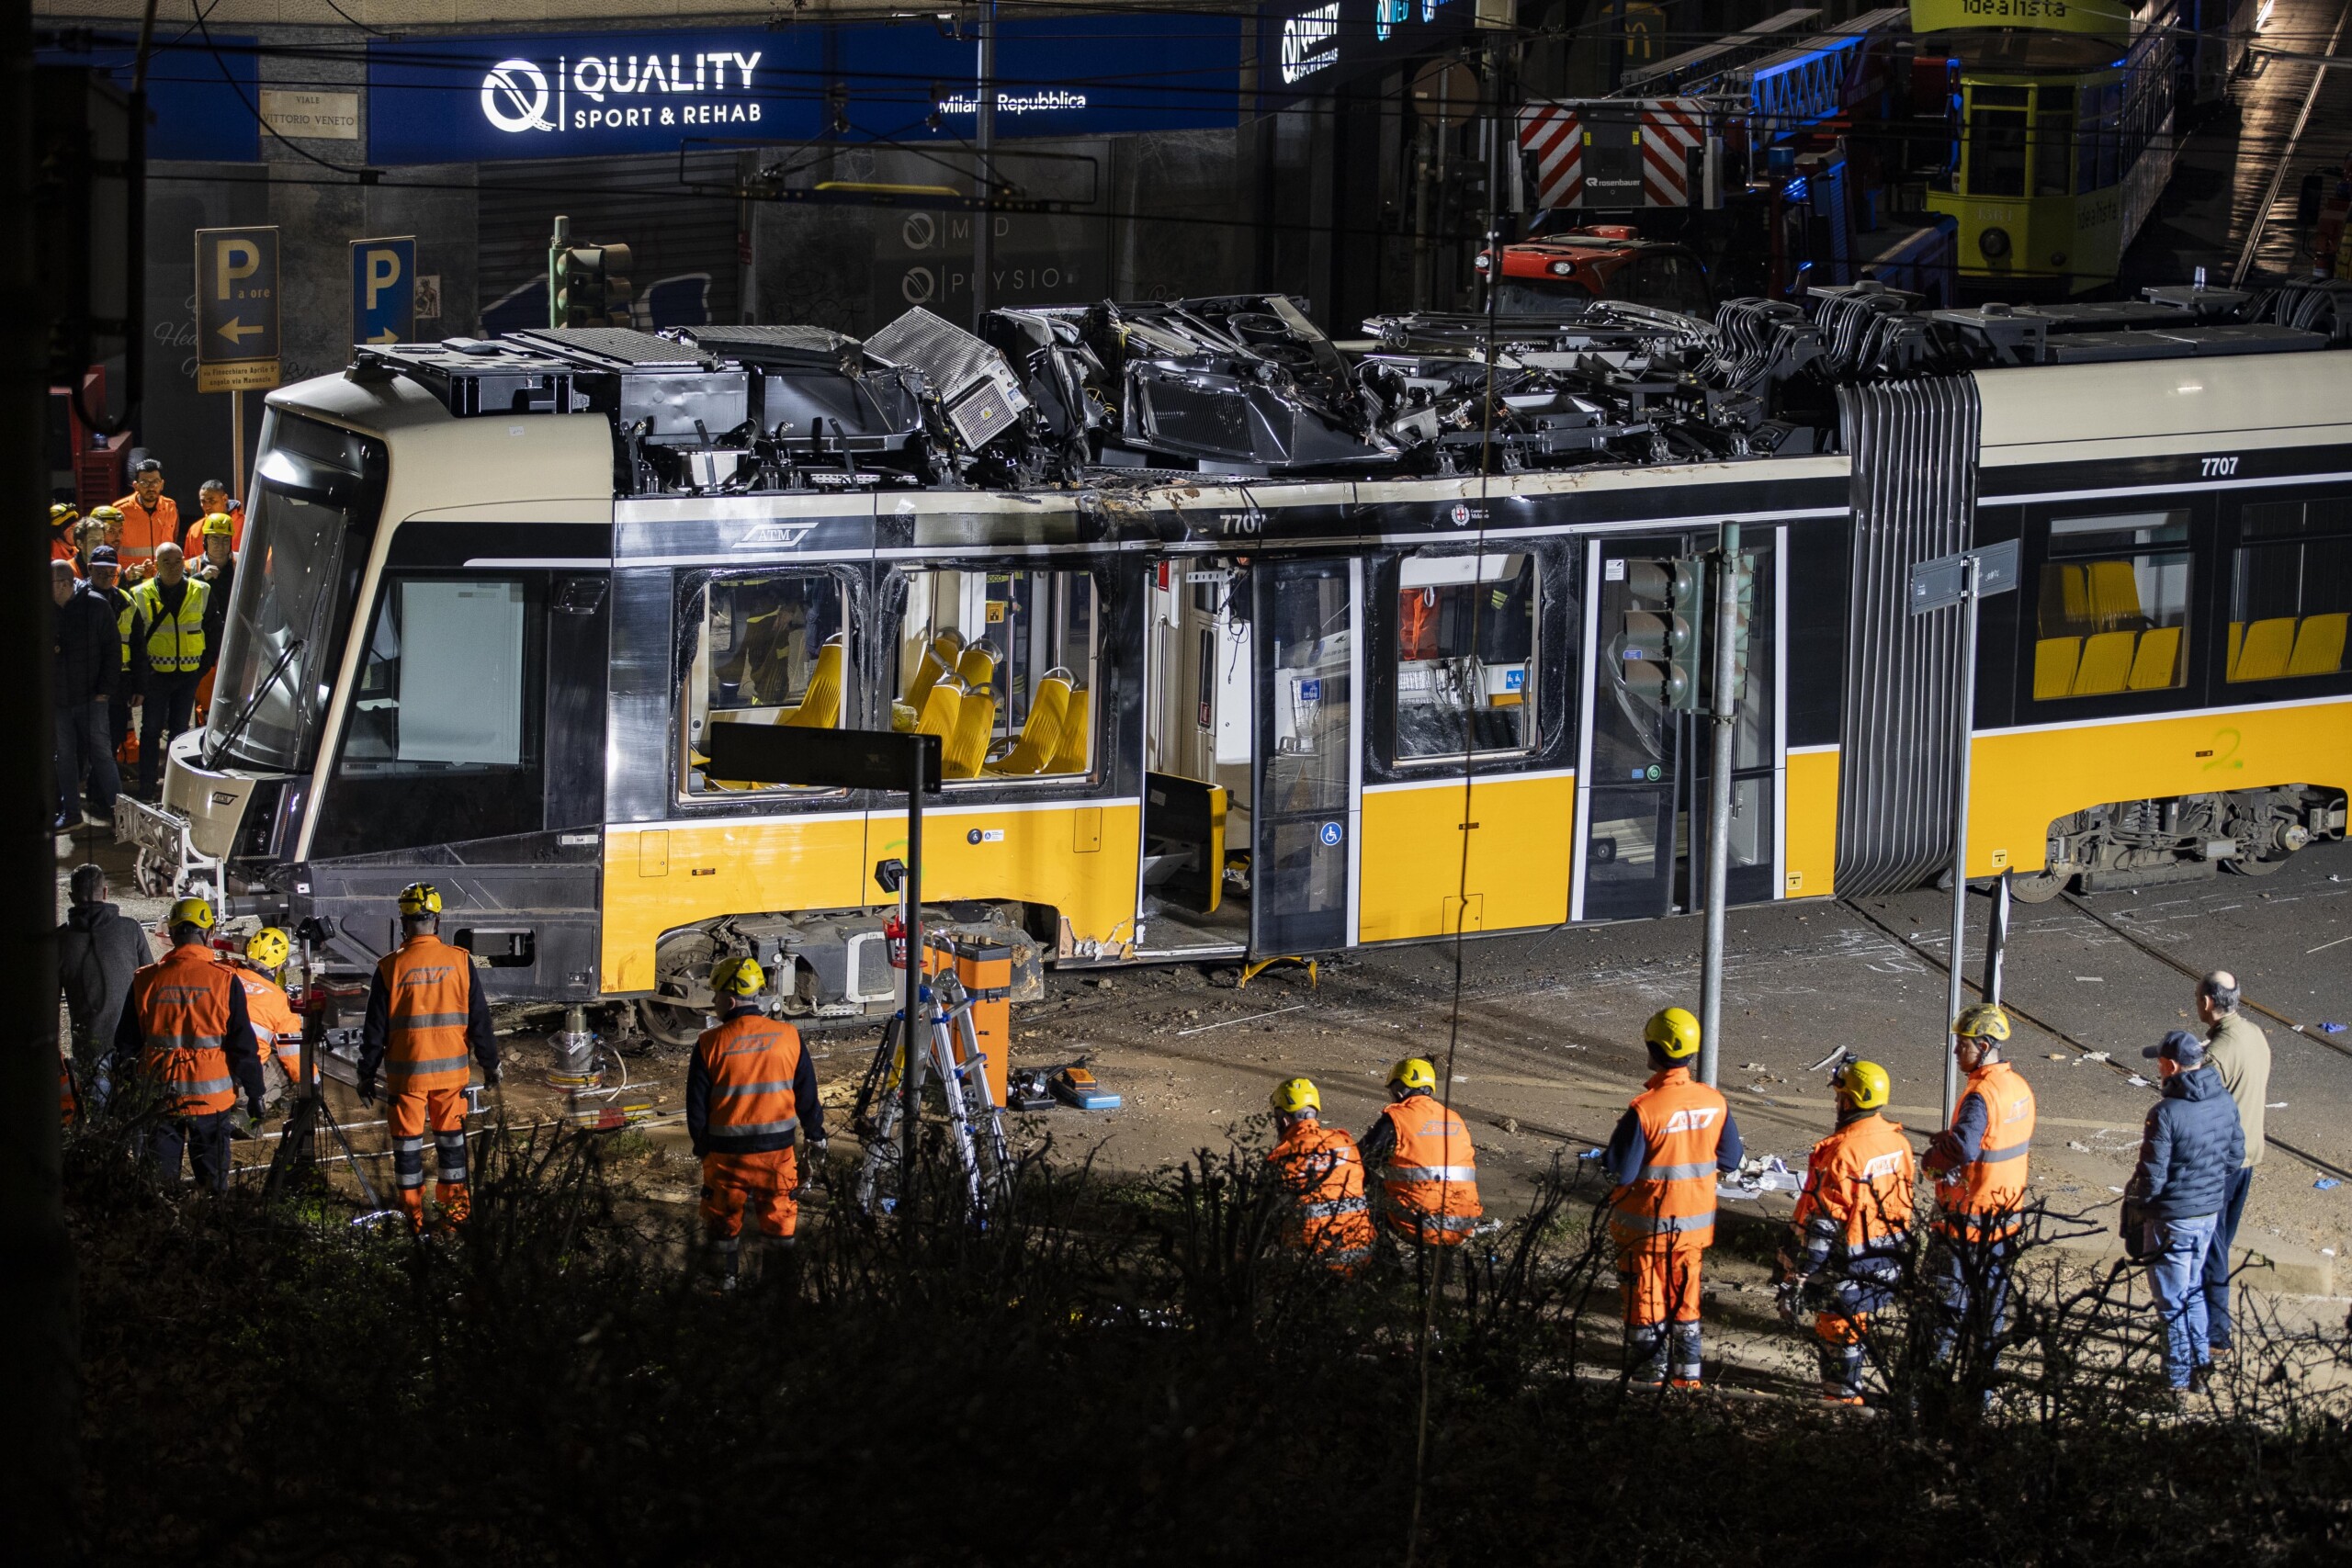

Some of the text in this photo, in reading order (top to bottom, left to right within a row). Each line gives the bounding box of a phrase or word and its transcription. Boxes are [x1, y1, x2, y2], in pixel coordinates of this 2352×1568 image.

[1962, 0, 2065, 17] idealista
[1300, 3, 1340, 52] QUALITY
[574, 52, 762, 102] QUALITY
[296, 96, 321, 105] VIALE
[997, 91, 1086, 115] Repubblica
[264, 114, 355, 126] VITTORIO VENETO
[575, 104, 762, 129] SPORT & REHAB
[1599, 178, 1641, 186] rosenbauer
[952, 217, 1009, 239] MD
[217, 239, 261, 300] P
[367, 249, 401, 310] P
[238, 288, 271, 299] a ore
[2201, 457, 2239, 477] 7707
[1219, 514, 1267, 534] 7707
[756, 529, 791, 542] ATM
